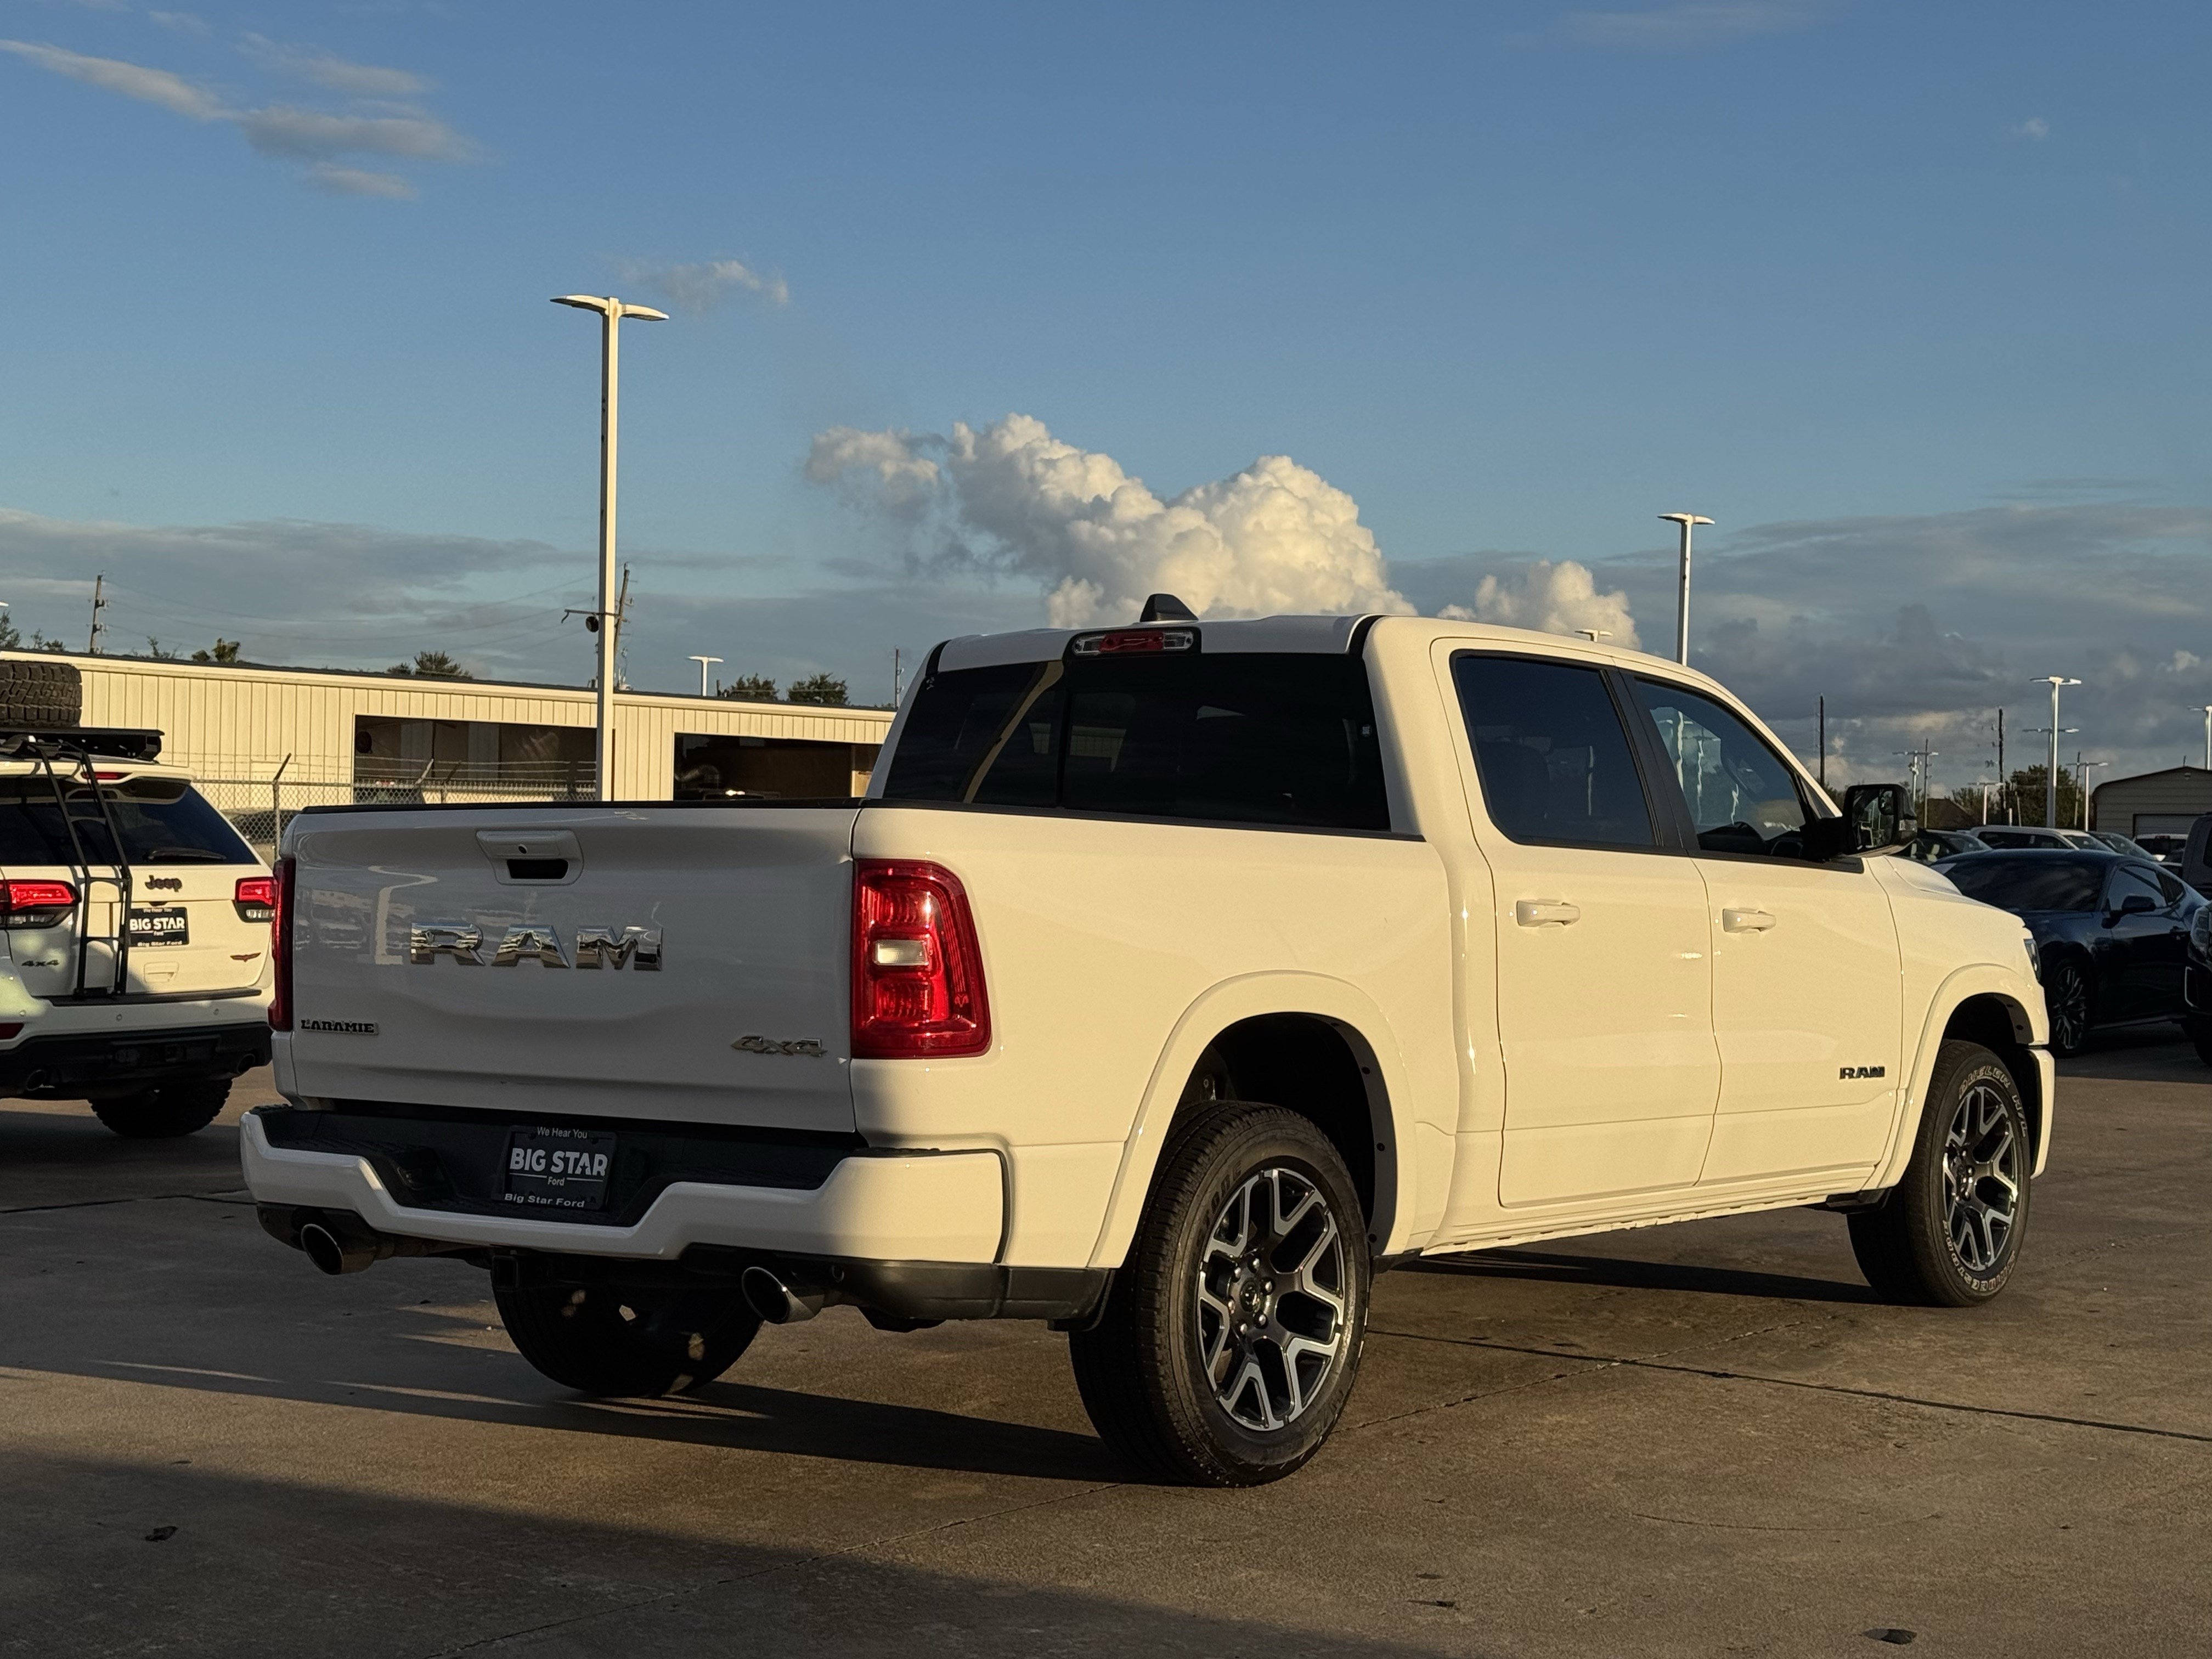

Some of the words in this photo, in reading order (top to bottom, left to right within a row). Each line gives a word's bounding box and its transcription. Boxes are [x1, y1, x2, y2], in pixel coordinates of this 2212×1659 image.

[145, 875, 183, 892] Jeep
[129, 918, 151, 931] BIG
[153, 917, 185, 930] STAR
[410, 922, 663, 971] RAM
[21, 959, 59, 967] 4x4
[301, 1019, 375, 1034] LARAMIE
[730, 1035, 827, 1058] 4x4
[1839, 1066, 1885, 1080] RAM
[1959, 1065, 2011, 1100] DUELER
[537, 1126, 550, 1136] We
[551, 1127, 571, 1137] Hear
[573, 1128, 588, 1139] You
[509, 1148, 546, 1172] BIG
[550, 1150, 608, 1177] STAR
[548, 1176, 565, 1186] Ford
[504, 1193, 524, 1203] Big
[527, 1195, 554, 1205] Star
[556, 1198, 585, 1208] Ford
